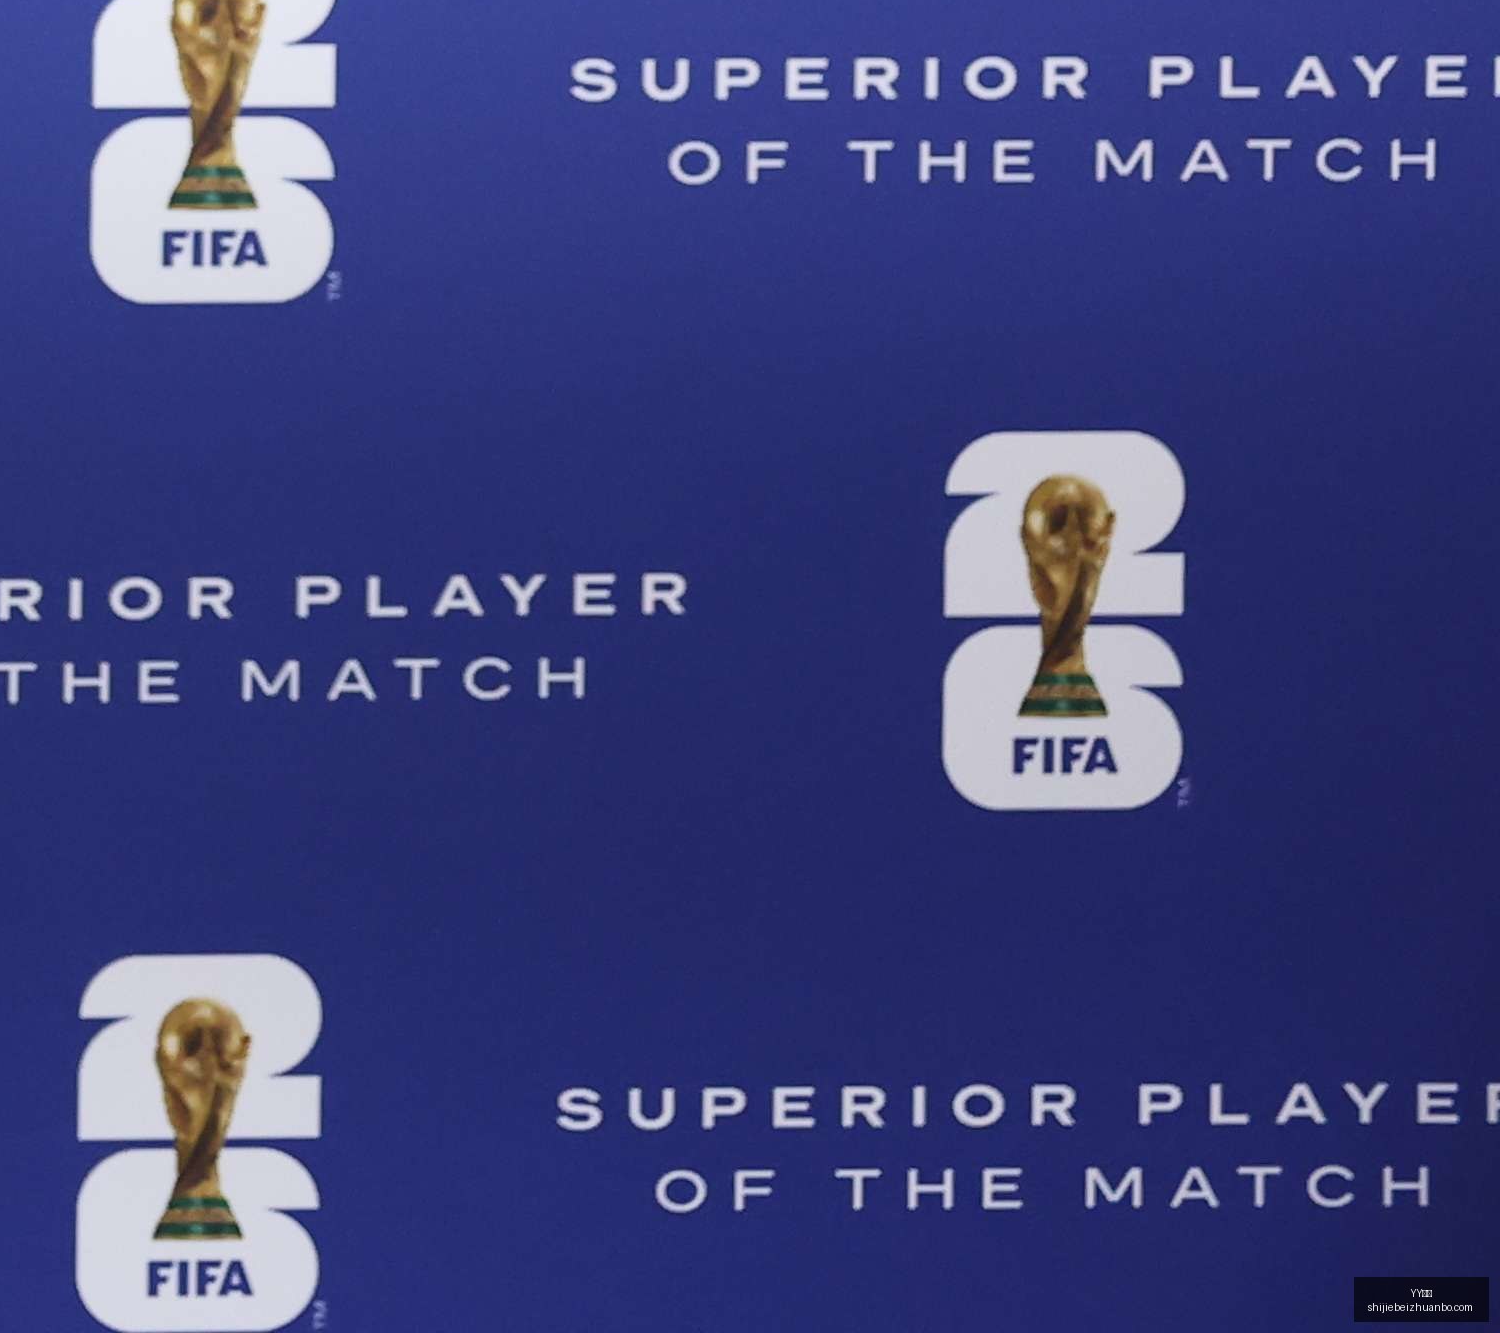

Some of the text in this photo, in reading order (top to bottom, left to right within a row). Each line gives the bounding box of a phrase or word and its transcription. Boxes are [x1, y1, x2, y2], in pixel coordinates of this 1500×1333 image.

[569, 54, 1500, 103] SUPERIOR PLAYE
[667, 137, 1437, 186] OF THE MATCH
[161, 229, 269, 268] FIFA
[294, 571, 688, 620] PLAYER
[240, 655, 586, 703] MATCH
[1014, 738, 1117, 775] FIFA
[555, 1082, 1077, 1132] SUPERIOR
[654, 1163, 1430, 1214] OF THE MATCH
[146, 1259, 253, 1298] FIFA
